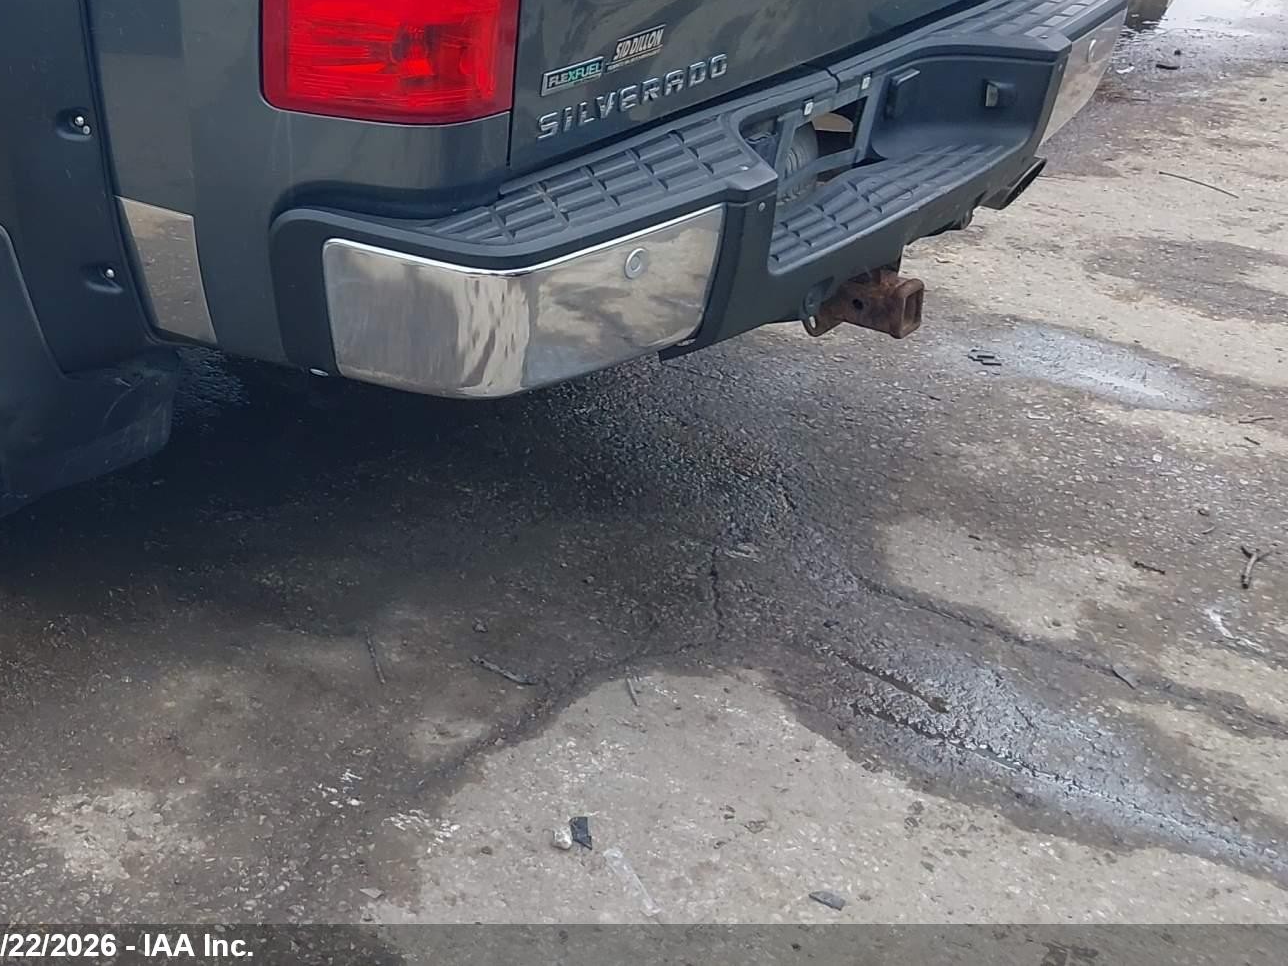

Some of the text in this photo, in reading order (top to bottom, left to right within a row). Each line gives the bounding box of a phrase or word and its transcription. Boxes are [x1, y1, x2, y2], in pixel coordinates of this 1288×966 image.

[613, 40, 631, 60] SID
[629, 28, 664, 55] DILLON
[536, 53, 728, 140] SILVERADO
